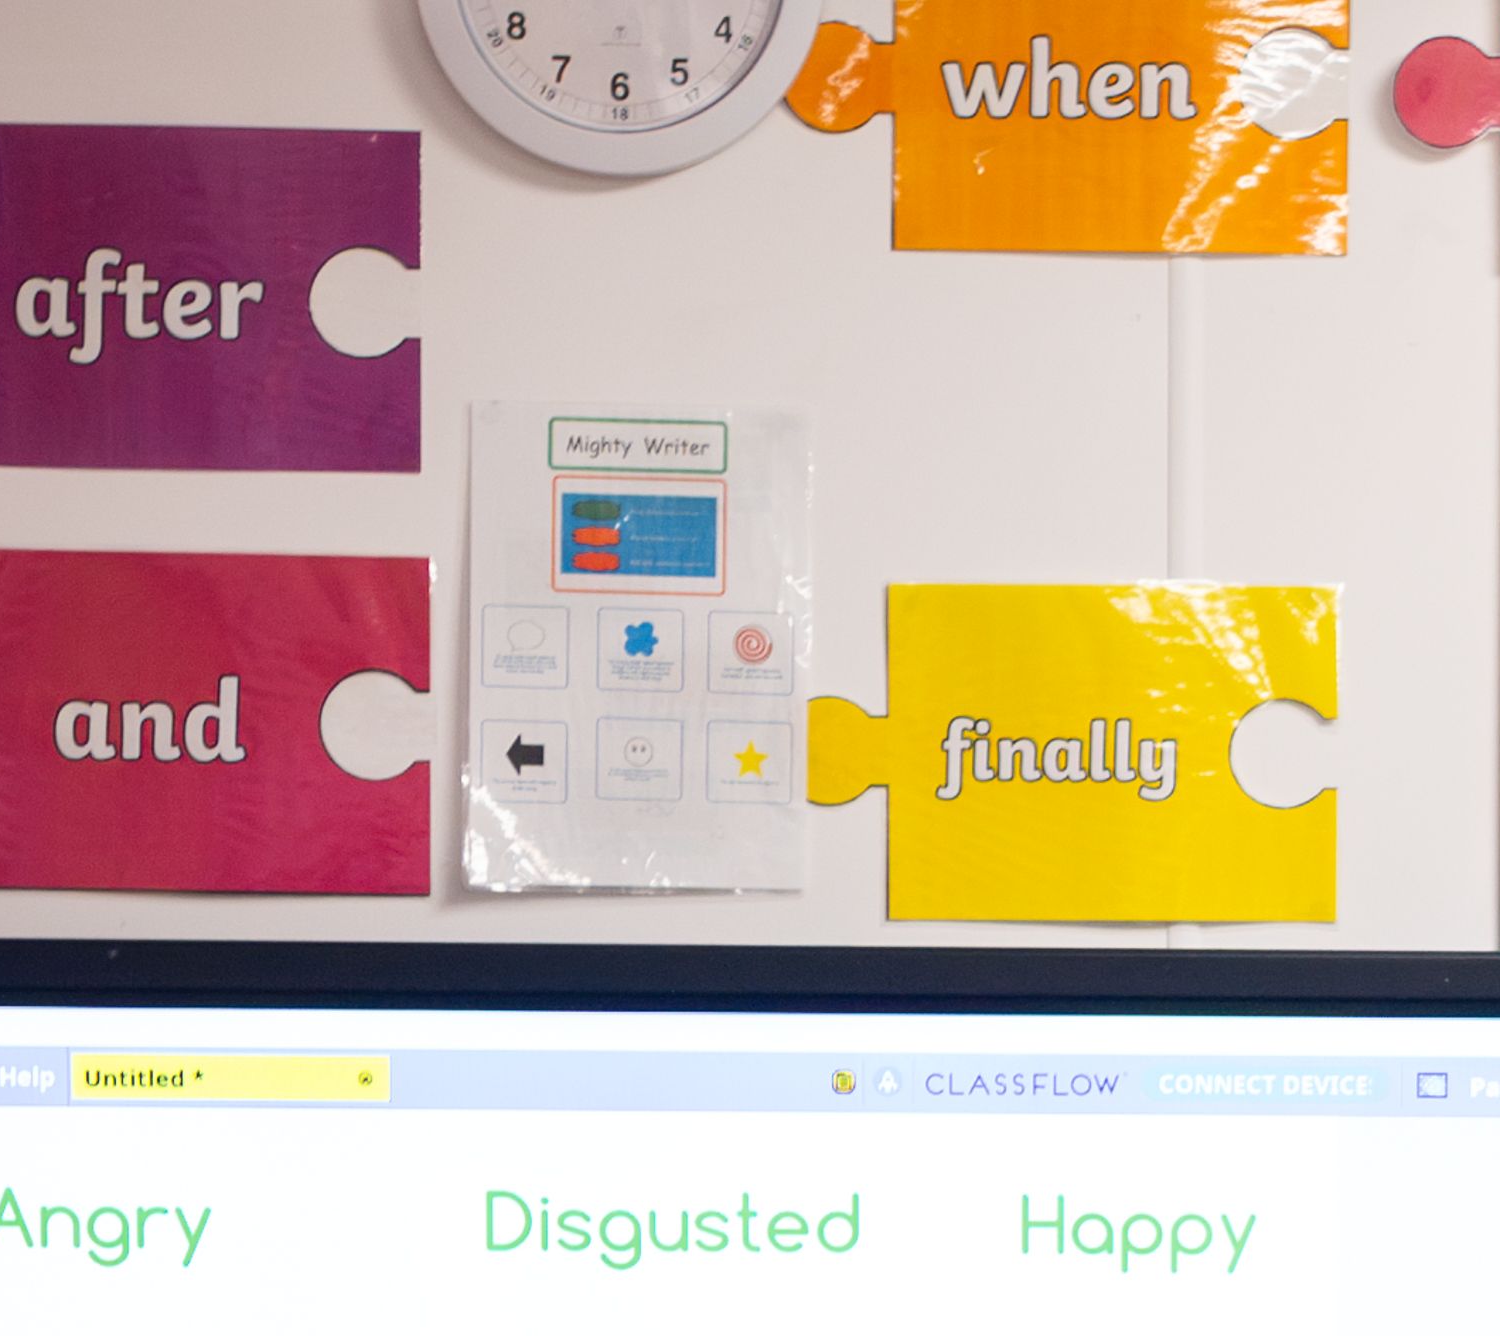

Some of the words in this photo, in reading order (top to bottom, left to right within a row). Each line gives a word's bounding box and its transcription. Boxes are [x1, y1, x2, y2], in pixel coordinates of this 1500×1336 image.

[506, 12, 526, 40] 8
[714, 16, 732, 43] 4
[552, 55, 571, 83] 7
[670, 58, 689, 85] 5
[940, 34, 1197, 121] when
[611, 73, 630, 101] 6
[612, 107, 629, 120] 18
[14, 246, 264, 366] after
[567, 434, 631, 461] Mighty
[644, 435, 711, 458] Writer
[53, 674, 247, 765] and
[934, 715, 1178, 802] finally
[0, 1066, 56, 1093] Help
[84, 1068, 186, 1089] Untitled
[924, 1071, 1122, 1097] CLASSFLOW
[1157, 1074, 1276, 1097] CONNECT
[485, 1190, 861, 1270] Disgusted
[1020, 1194, 1257, 1274] Happy
